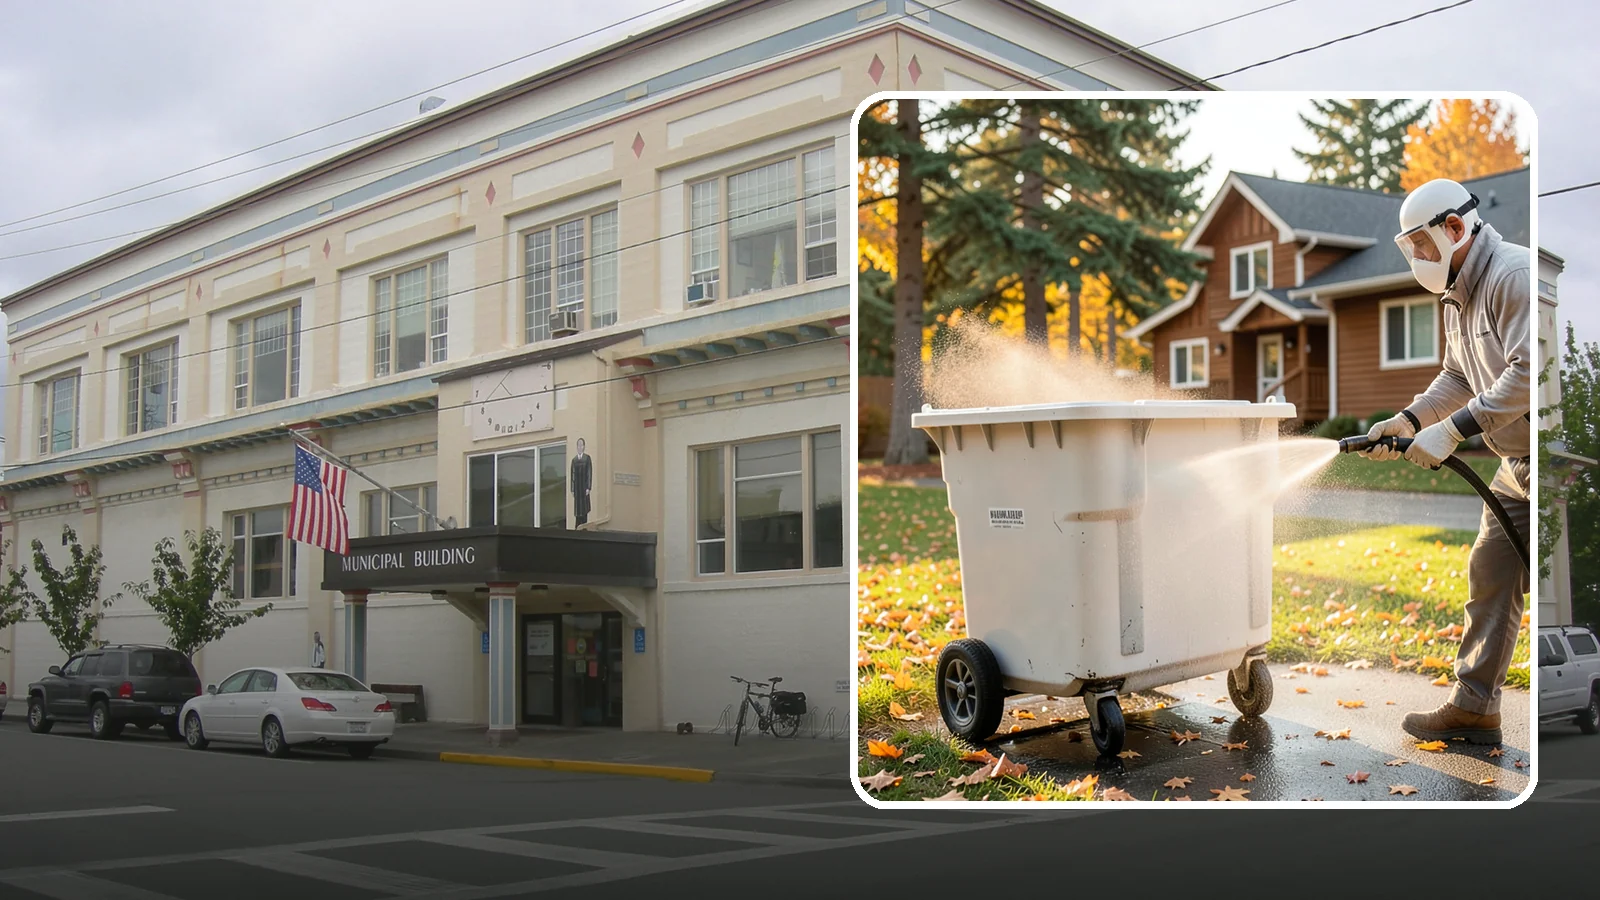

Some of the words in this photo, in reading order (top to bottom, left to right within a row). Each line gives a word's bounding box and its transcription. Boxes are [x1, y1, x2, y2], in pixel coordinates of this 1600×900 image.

[481, 407, 485, 415] 8
[488, 417, 492, 426] 9
[494, 423, 500, 432] 10
[501, 425, 506, 434] 11
[507, 425, 513, 434] 12
[521, 420, 526, 428] 2
[528, 413, 533, 422] 3
[536, 402, 540, 410] 4
[342, 552, 405, 571] MUNICIPAL
[414, 546, 475, 567] BUILDING
